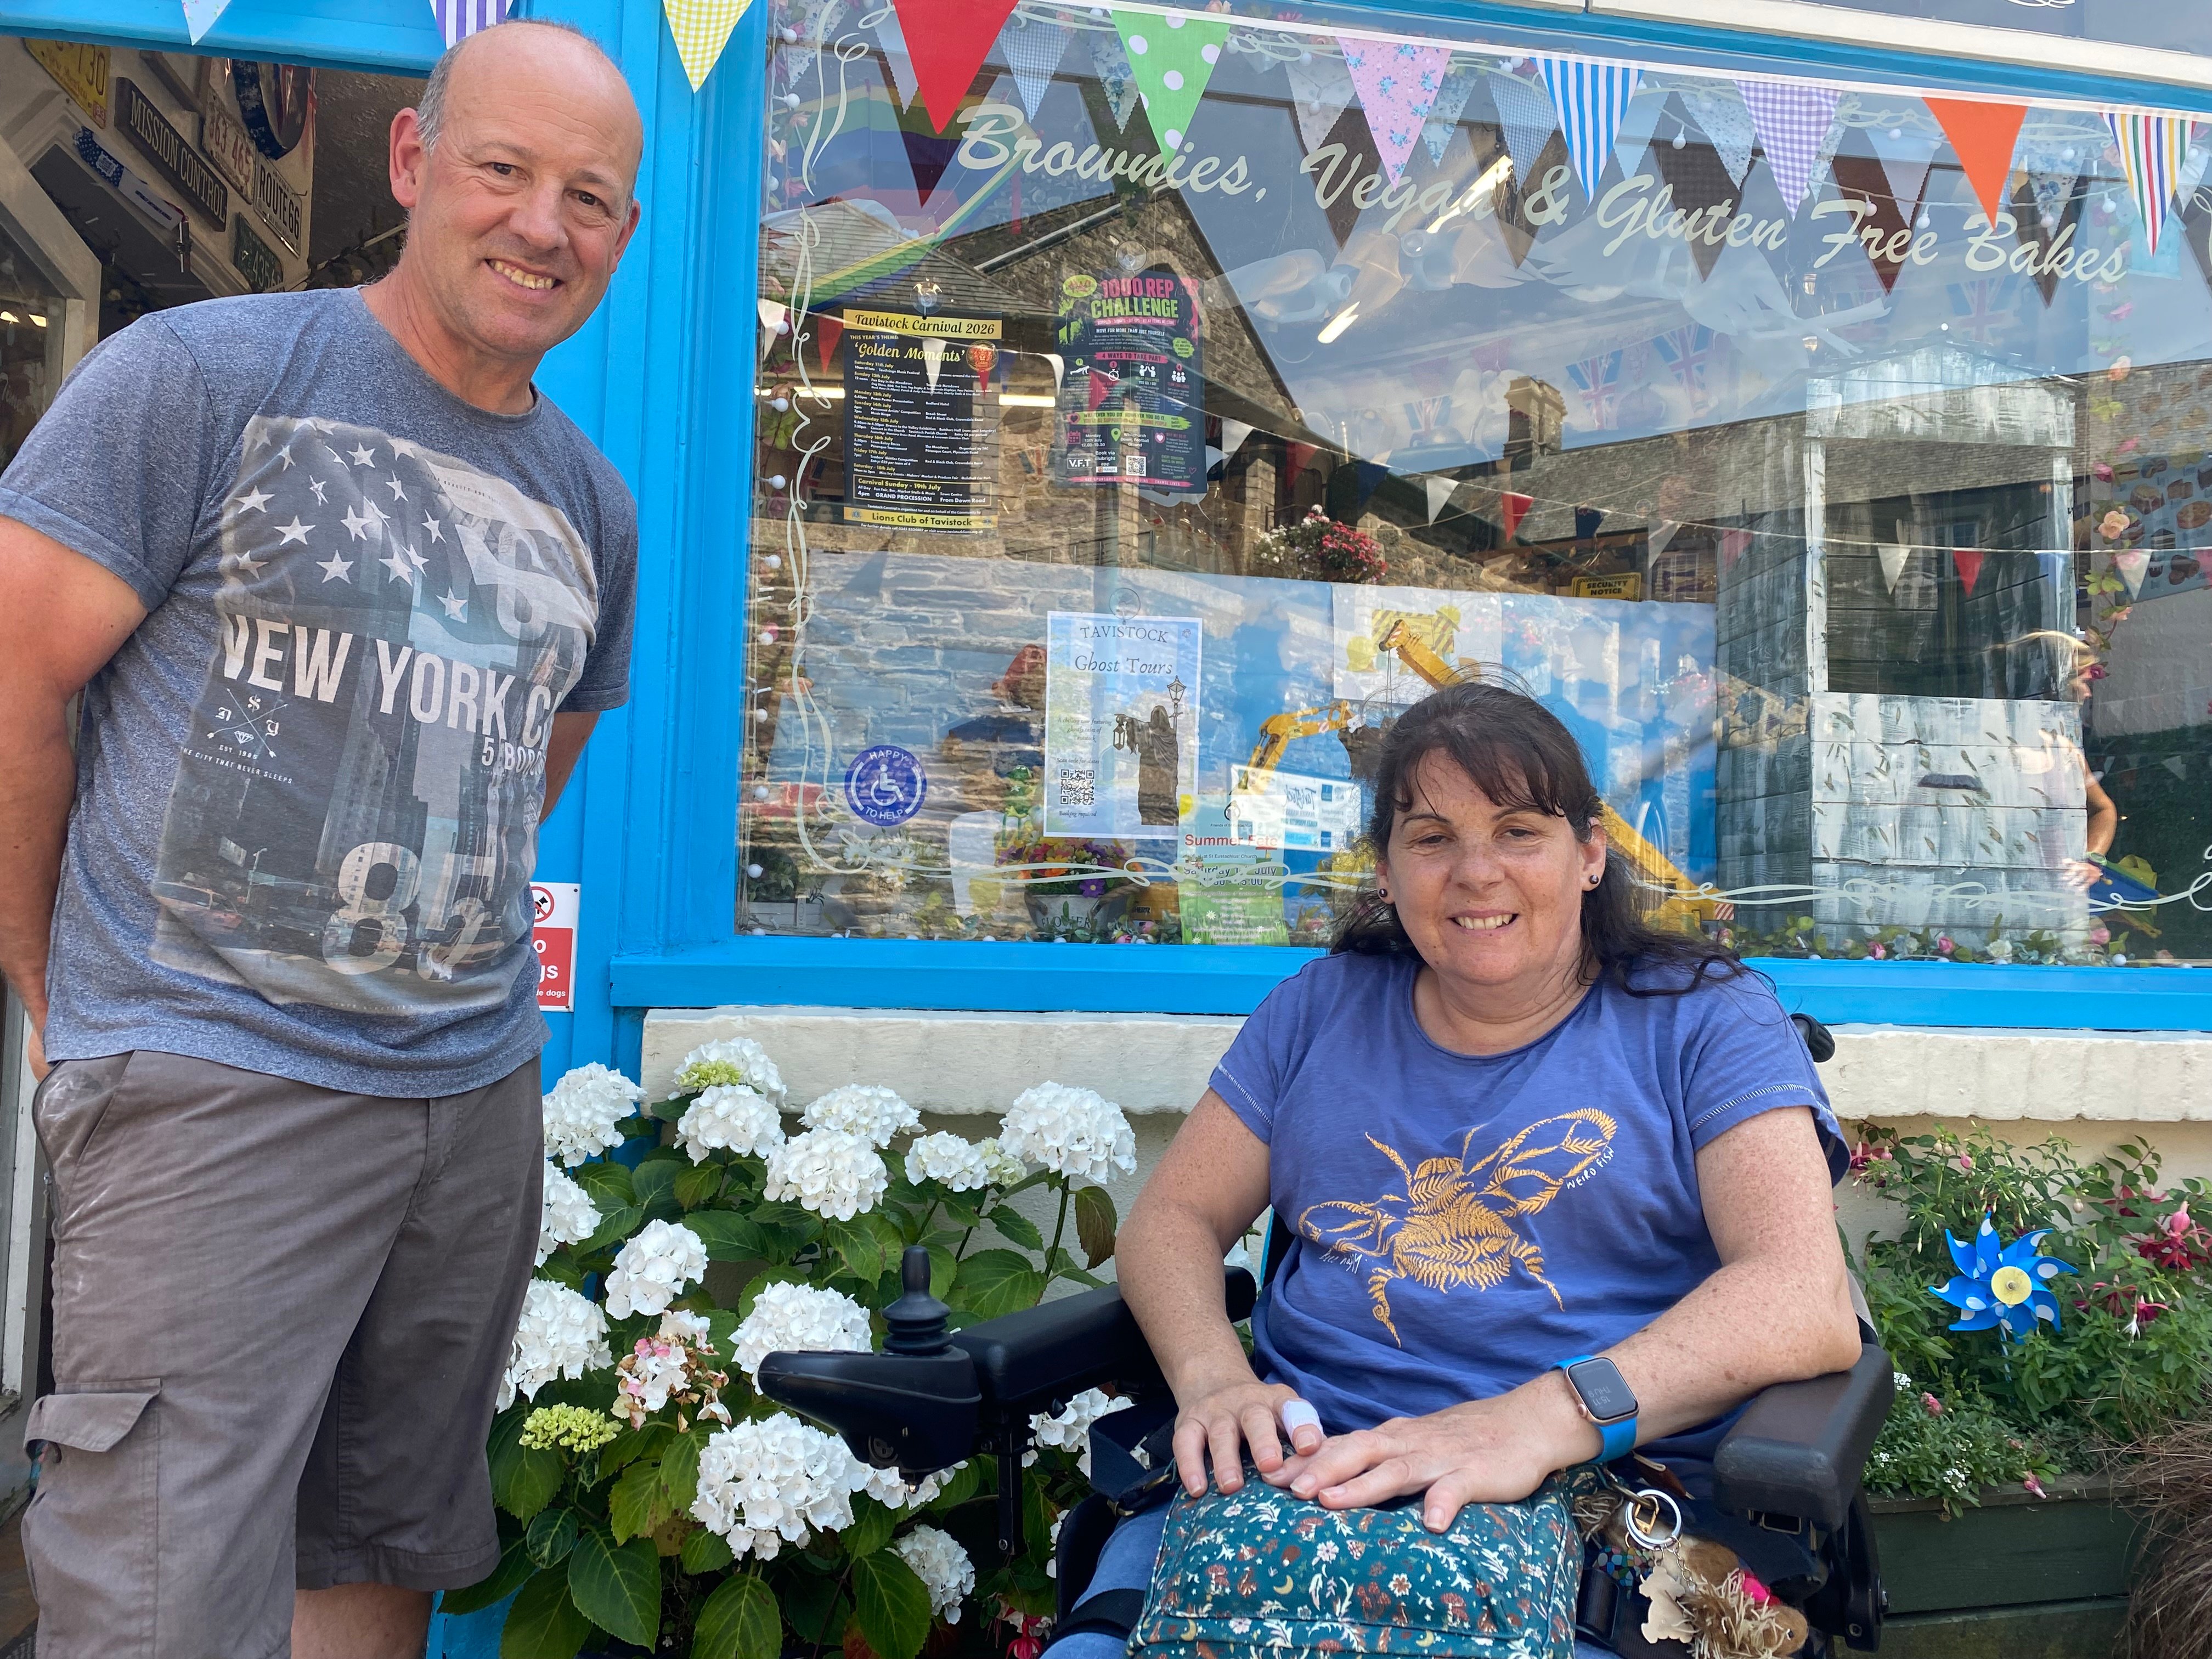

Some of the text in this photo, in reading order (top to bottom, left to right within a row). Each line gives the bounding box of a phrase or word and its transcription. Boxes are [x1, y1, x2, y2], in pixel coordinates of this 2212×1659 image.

[130, 90, 179, 172] MISSION
[180, 146, 225, 224] CONTROL
[259, 164, 287, 228] ROUTE
[289, 198, 300, 240] 66
[957, 103, 2130, 283] Brownies, Vegan & Gluten Free Bakes
[1101, 278, 1144, 298] 1000
[1146, 278, 1174, 298] REP
[1091, 297, 1179, 318] CHALLENGE
[855, 314, 995, 334] Tavistock Carnival 2026
[1069, 459, 1091, 467] V.F.T
[858, 478, 884, 486] Carnival
[885, 481, 909, 489] Sunday
[872, 512, 895, 522] Lions
[897, 515, 917, 523] Club
[930, 517, 972, 526] Tavistock
[1587, 580, 1628, 589] SECURITY
[1590, 588, 1622, 596] NOTICE
[1080, 626, 1169, 644] TAVISTOCK
[1075, 652, 1173, 675] Ghost Tours
[221, 613, 354, 703] NEW
[375, 639, 518, 741] YORK
[1091, 718, 1112, 726] featuring
[481, 737, 495, 766] 5
[870, 749, 908, 763] HAPPY
[195, 752, 213, 762] CITY
[216, 758, 234, 768] THAT
[237, 764, 261, 776] NEVER
[263, 771, 293, 785] SLEEPS
[865, 806, 904, 820] TO HELP
[1184, 834, 1243, 847] Summer
[1254, 866, 1277, 876] July
[546, 989, 566, 998] dogs
[1566, 1145, 1615, 1190] WEIRD FISH
